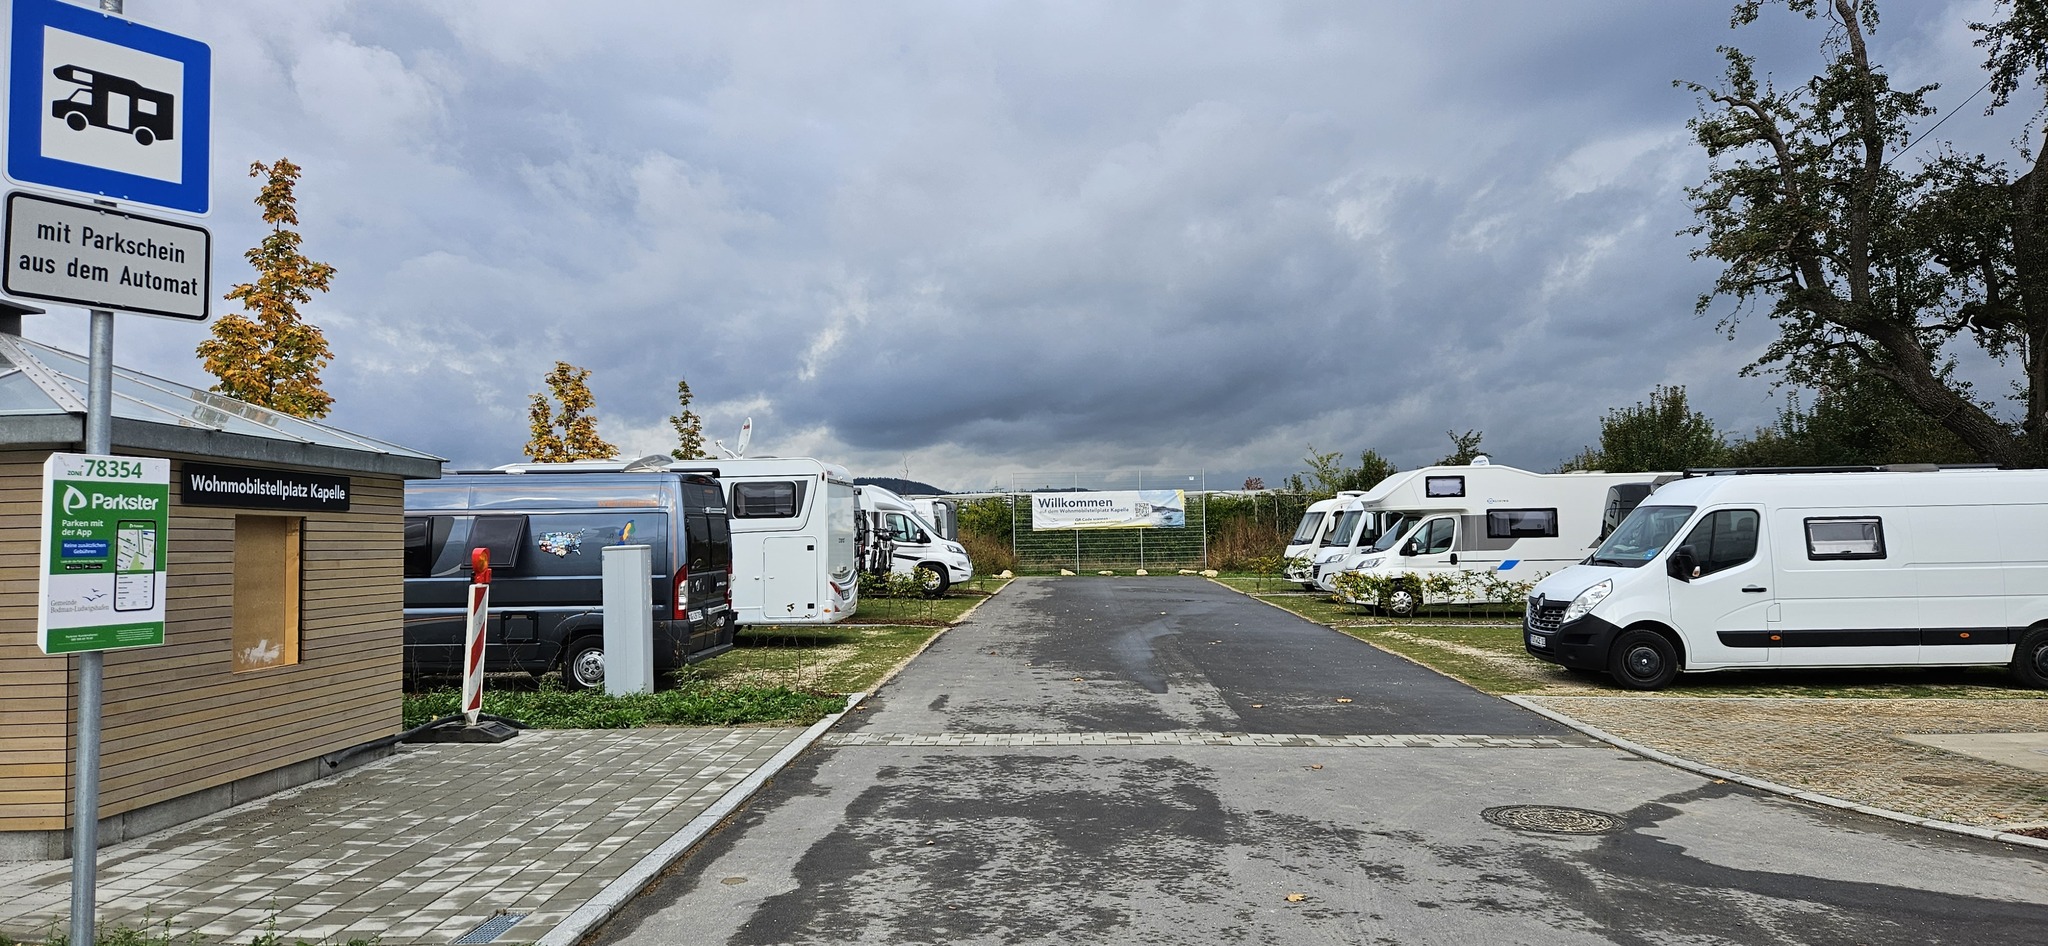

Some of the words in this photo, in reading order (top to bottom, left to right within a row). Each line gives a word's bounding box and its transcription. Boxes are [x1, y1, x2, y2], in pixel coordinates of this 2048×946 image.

[37, 221, 71, 244] mit
[82, 226, 185, 264] Parkschein
[19, 254, 56, 274] aus
[67, 257, 109, 282] dem
[119, 265, 198, 296] Automat
[85, 460, 142, 478] 78354
[191, 474, 308, 500] Wohnmobilstellplatz
[311, 483, 345, 502] Kapelle
[92, 493, 158, 510] Parkster
[1038, 498, 1112, 507] Willkommen
[77, 529, 92, 537] App
